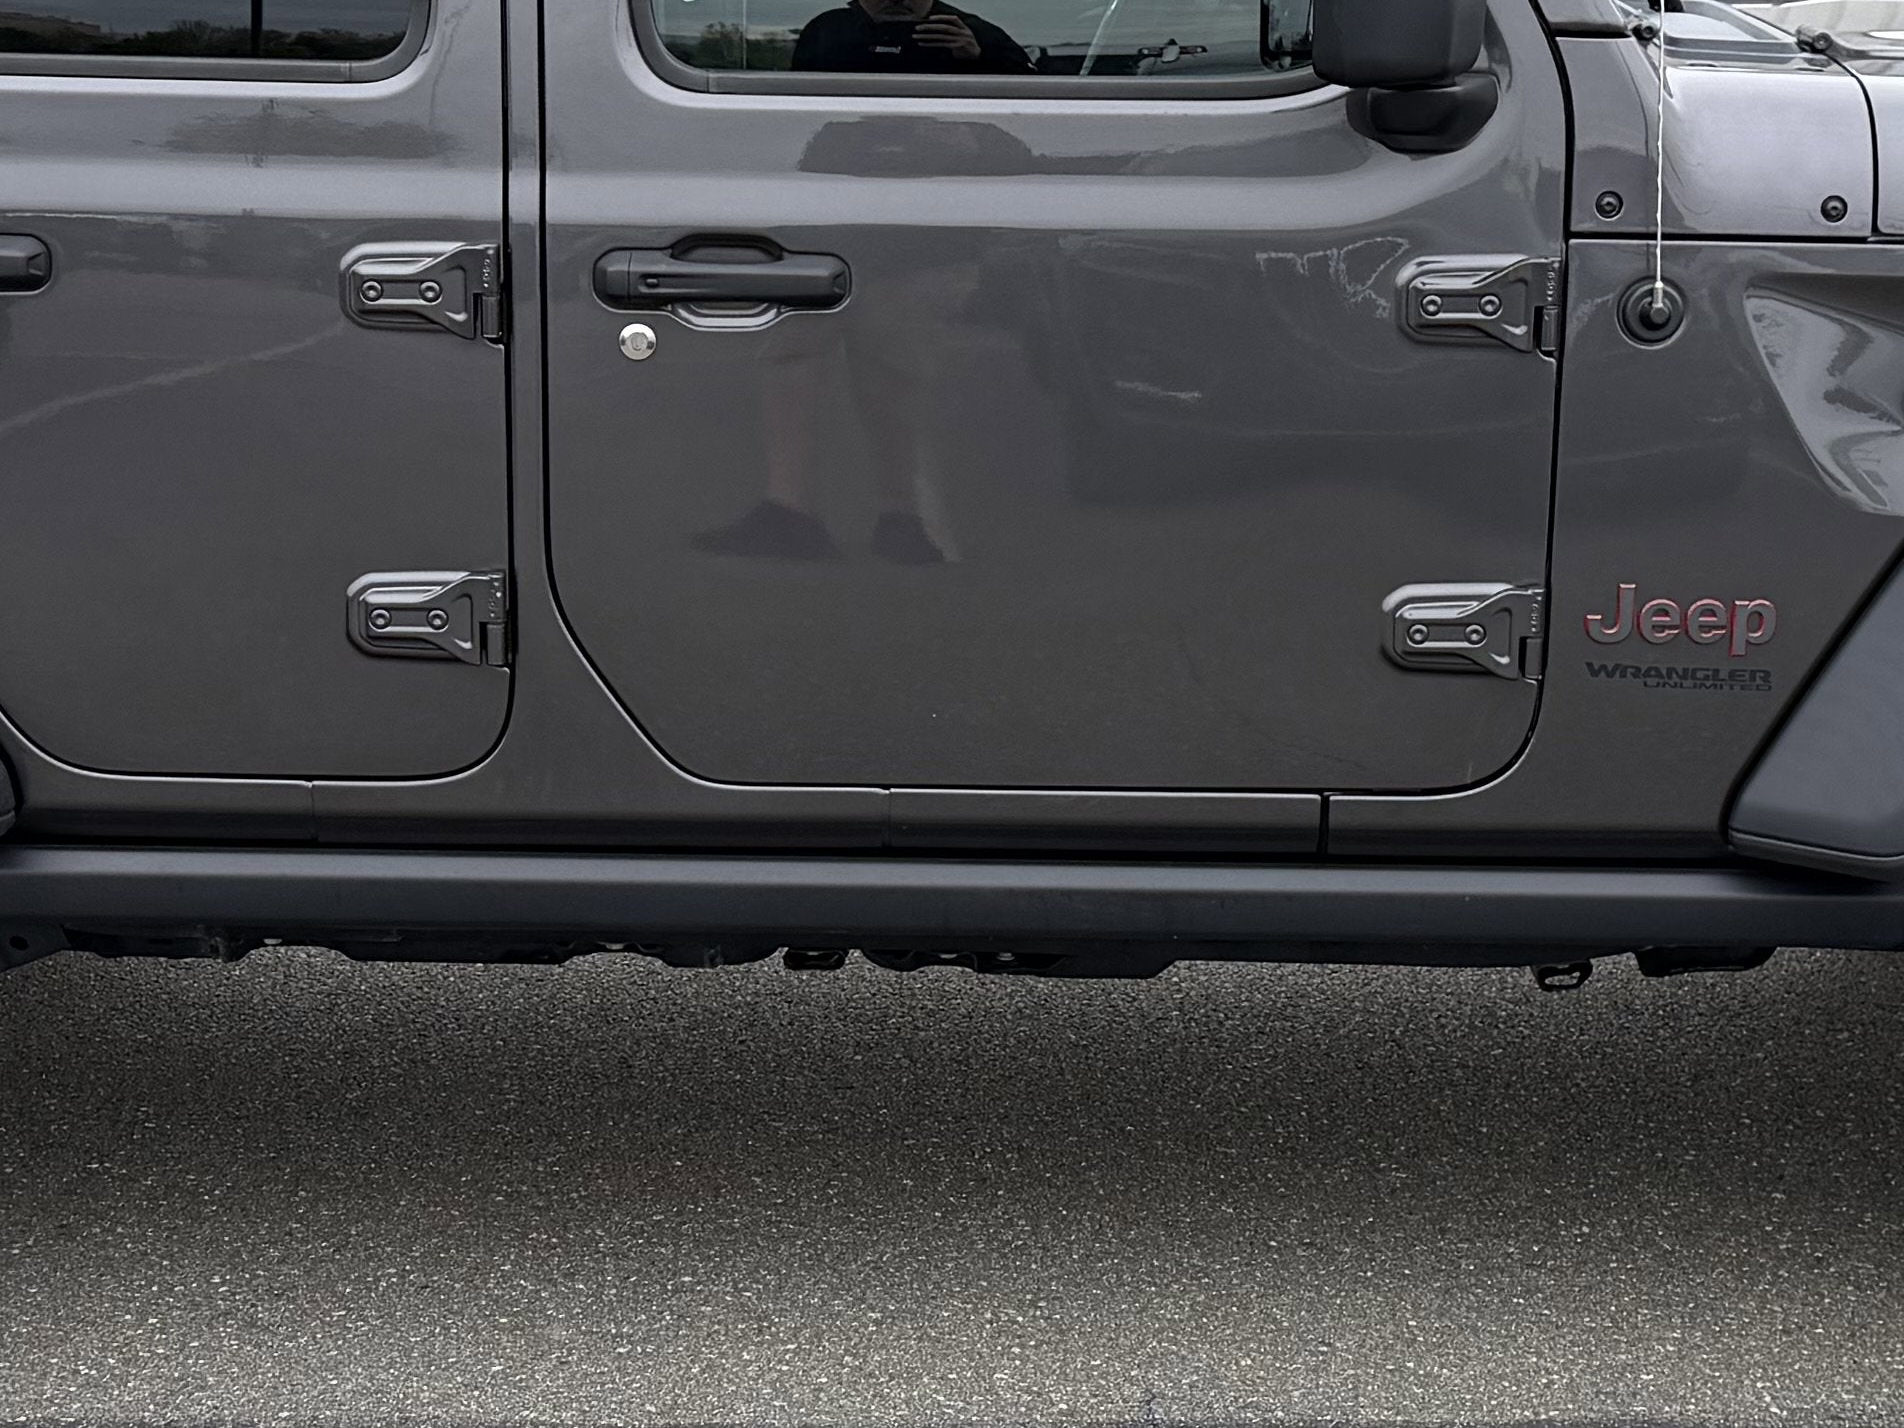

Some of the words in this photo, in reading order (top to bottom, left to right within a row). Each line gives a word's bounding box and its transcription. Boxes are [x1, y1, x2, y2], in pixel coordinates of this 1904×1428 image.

[1583, 583, 1777, 657] Jeep
[1585, 662, 1772, 683] WRANGLER
[1643, 681, 1772, 692] UNLIMITED
